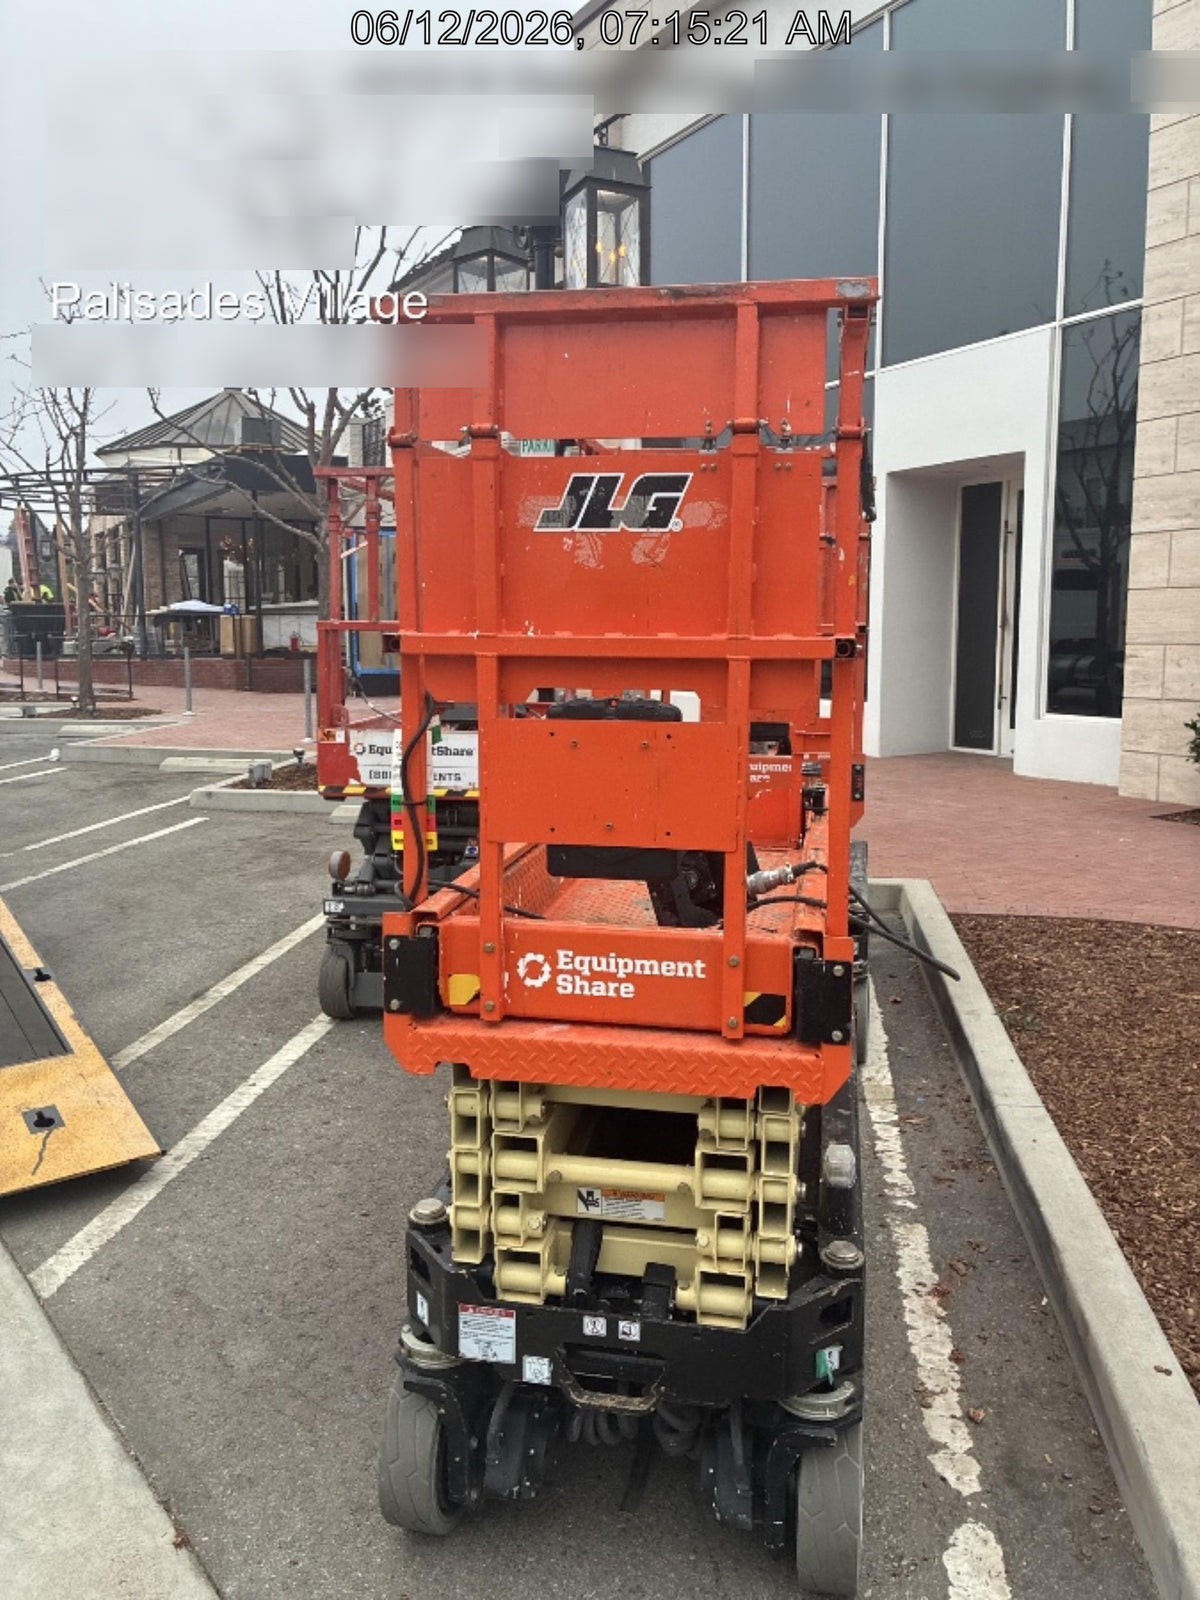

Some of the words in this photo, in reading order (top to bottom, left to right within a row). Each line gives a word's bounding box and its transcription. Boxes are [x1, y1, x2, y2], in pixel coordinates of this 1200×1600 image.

[533, 472, 694, 532] JLG
[556, 949, 707, 979] Equipment
[556, 974, 636, 998] Share
